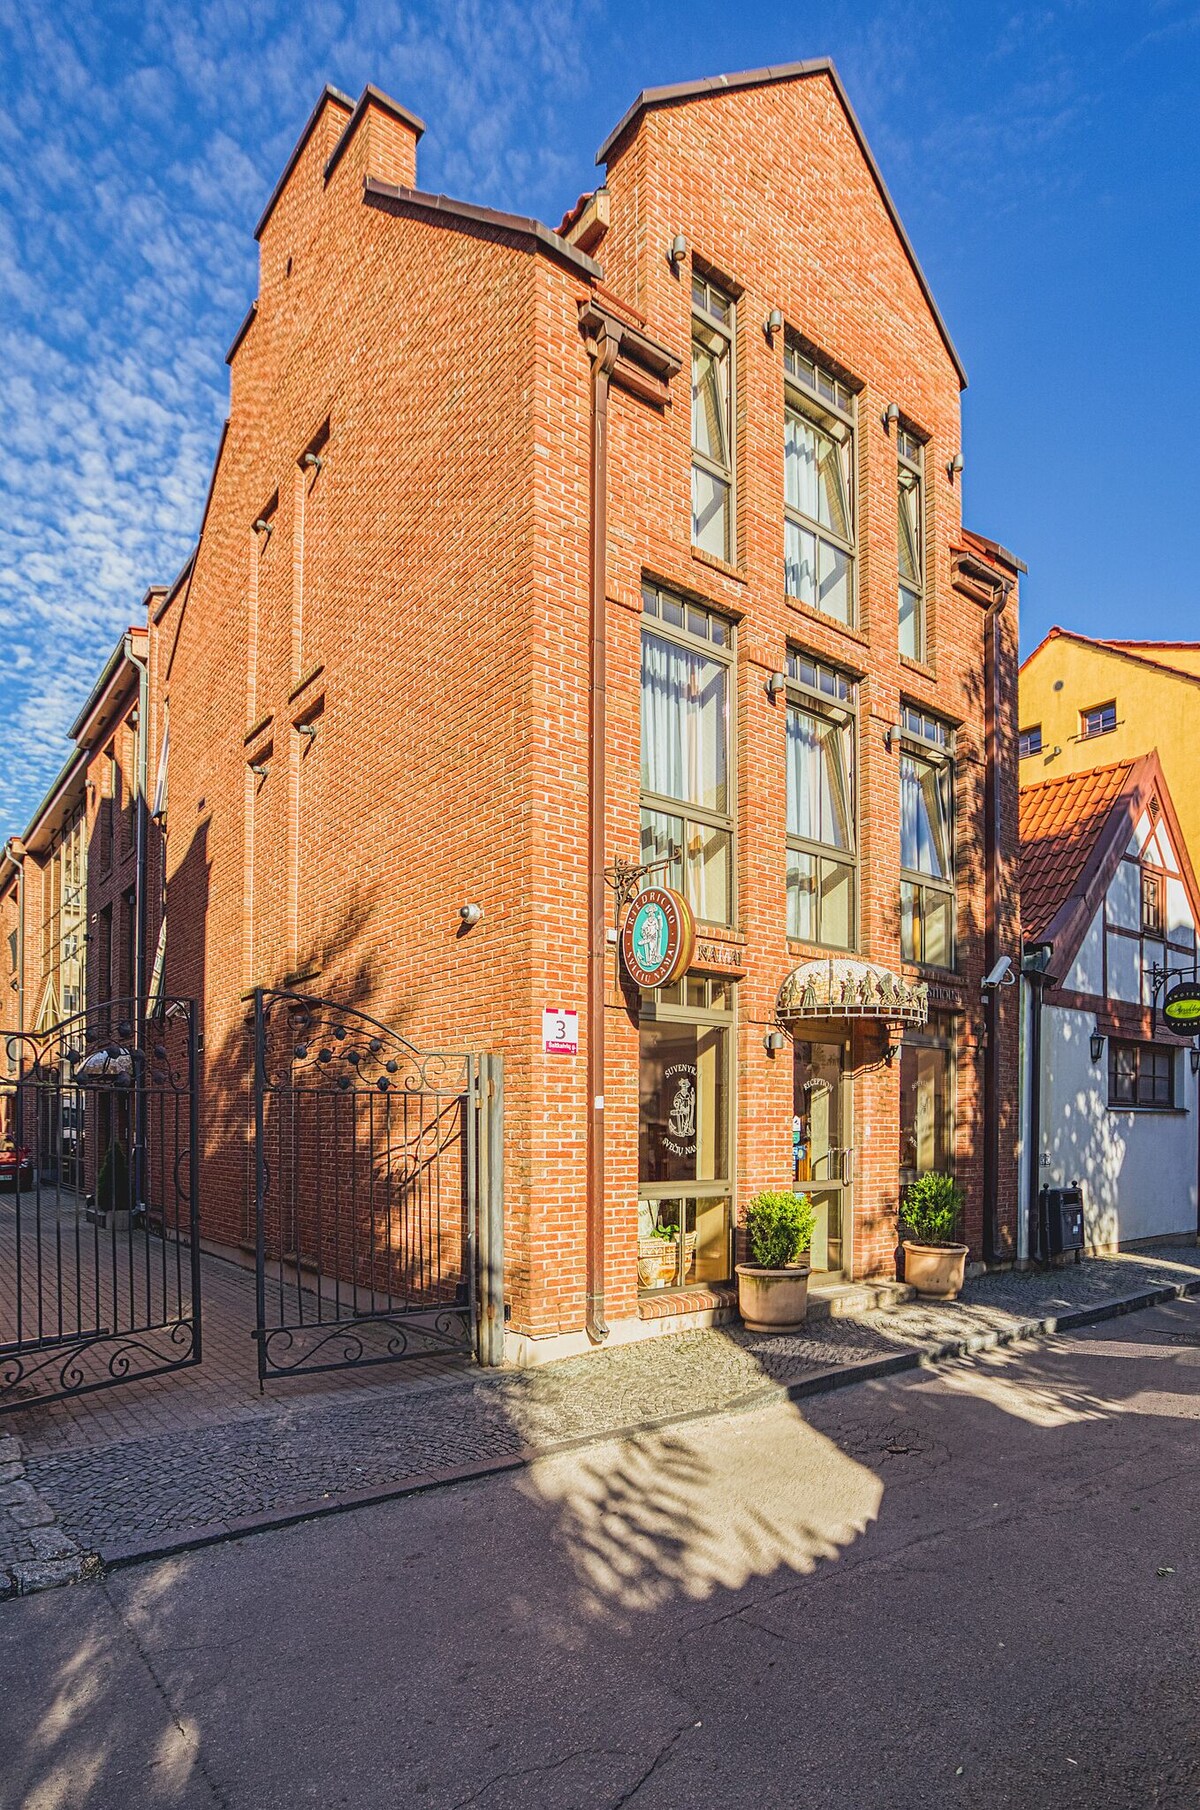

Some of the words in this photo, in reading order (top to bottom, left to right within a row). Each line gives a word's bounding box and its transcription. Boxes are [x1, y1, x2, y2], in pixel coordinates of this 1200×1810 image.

[555, 1020, 566, 1040] 3
[664, 1063, 698, 1079] SUVENYR
[803, 1077, 834, 1093] RECEPTION
